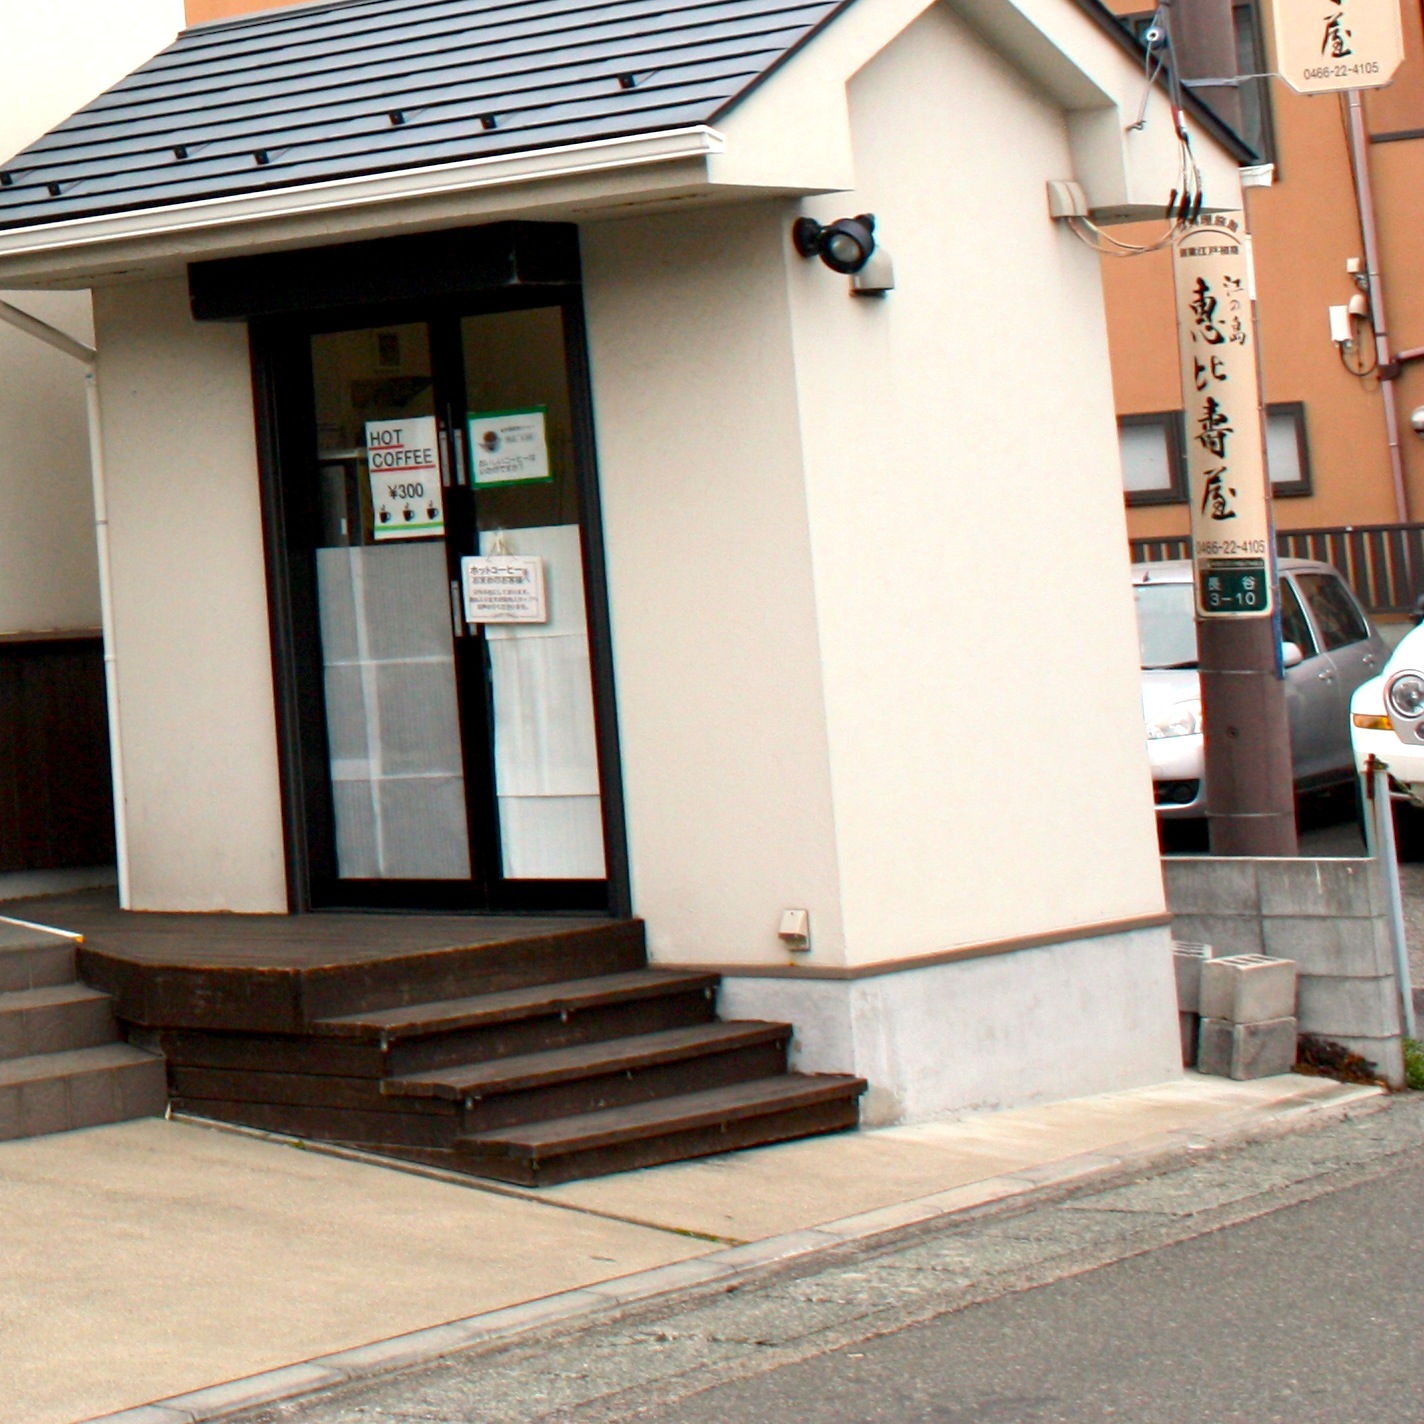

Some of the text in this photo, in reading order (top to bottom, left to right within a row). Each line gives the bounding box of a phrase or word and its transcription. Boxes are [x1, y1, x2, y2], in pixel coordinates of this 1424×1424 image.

[1303, 61, 1379, 80] 0466-22-4105
[369, 428, 404, 447] HOT
[371, 448, 434, 469] COFFEE
[388, 481, 424, 500] ¥300
[1210, 591, 1257, 606] 3-10
